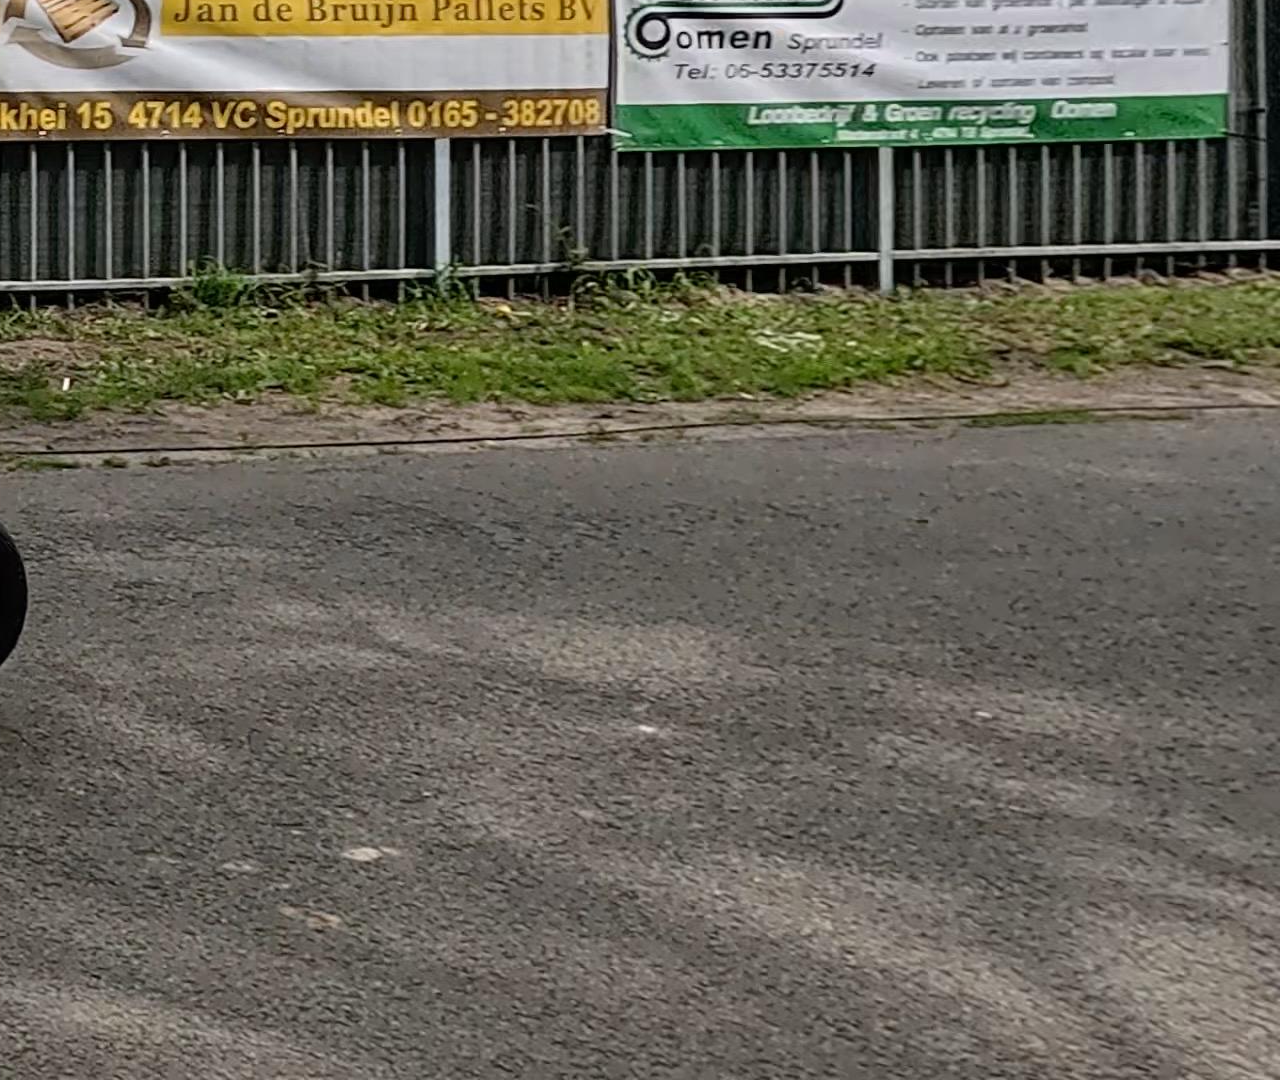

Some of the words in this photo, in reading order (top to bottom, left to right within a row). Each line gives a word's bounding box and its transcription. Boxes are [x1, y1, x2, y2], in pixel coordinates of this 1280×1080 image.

[786, 33, 884, 55] Sprundel
[725, 62, 877, 79] 06-53375514
[76, 101, 113, 130] 15
[127, 101, 203, 129] 4714
[210, 100, 257, 129] VC
[264, 100, 400, 135] Sprundel
[407, 99, 479, 128] 0165
[502, 97, 602, 127] 382708
